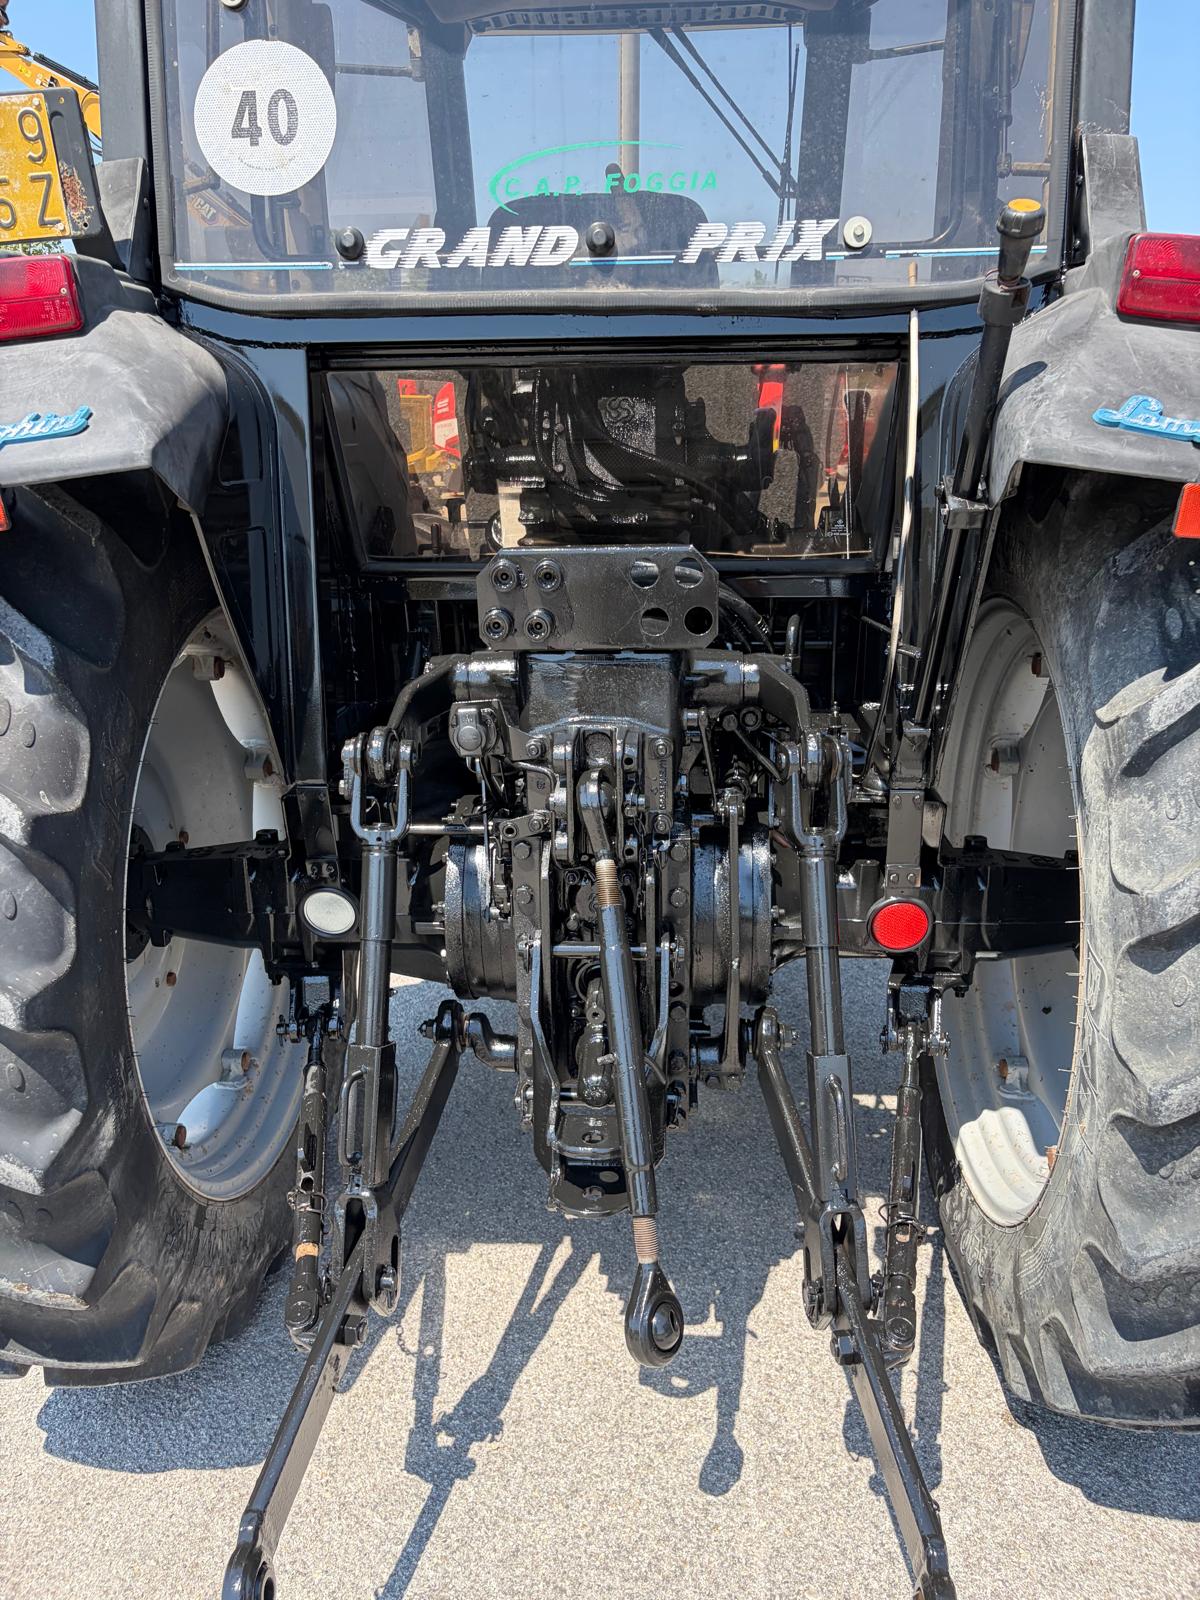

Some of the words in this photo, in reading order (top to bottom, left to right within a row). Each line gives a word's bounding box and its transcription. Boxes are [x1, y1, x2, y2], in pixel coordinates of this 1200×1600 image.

[17, 106, 47, 164] 9
[231, 88, 299, 147] 40
[193, 197, 217, 220] CAT
[504, 175, 583, 198] C.A.P.
[605, 169, 718, 194] FOGGIA
[363, 225, 579, 270] GRAND
[679, 218, 839, 264] PRIX
